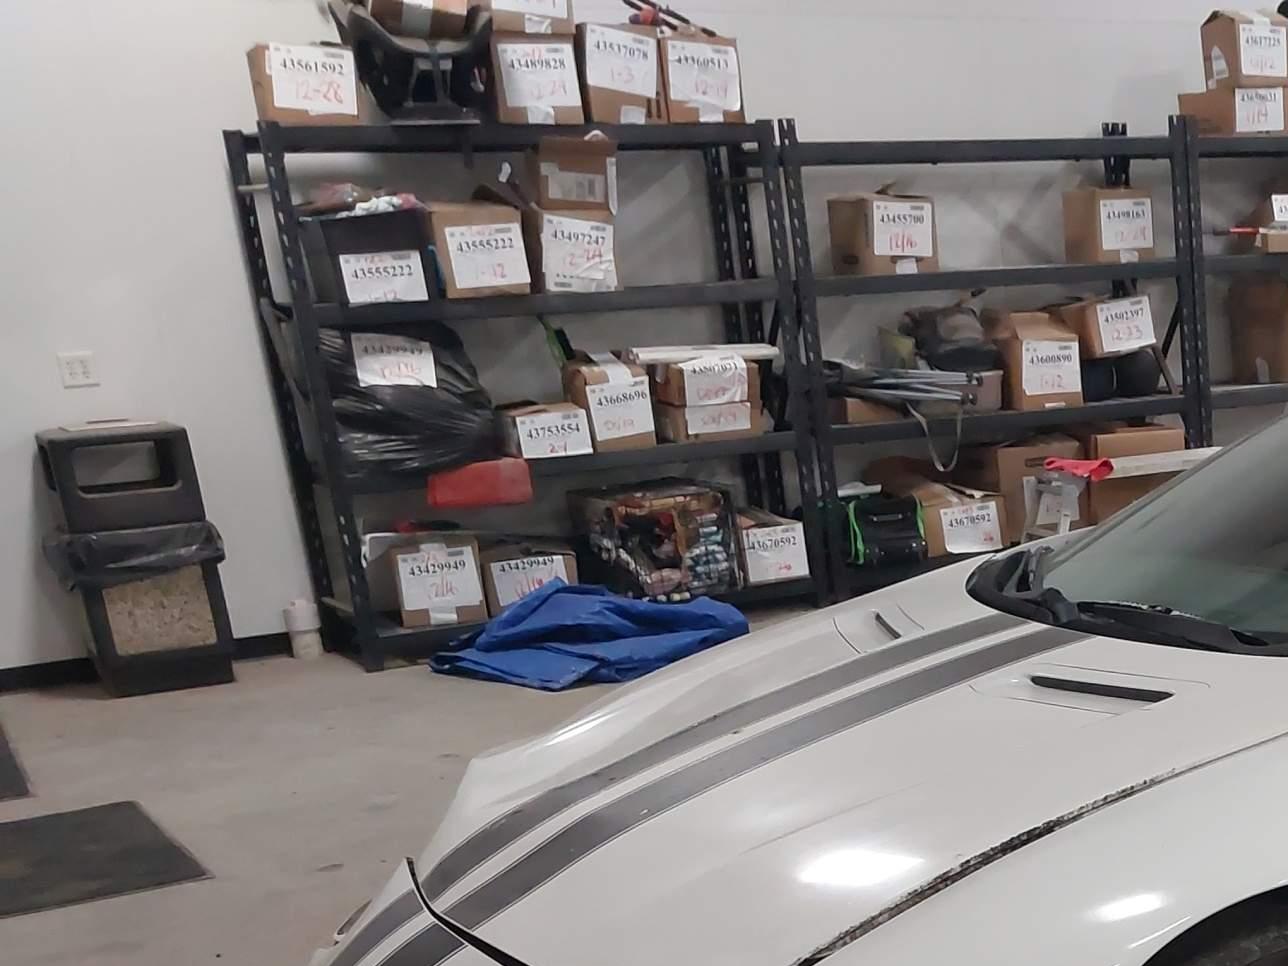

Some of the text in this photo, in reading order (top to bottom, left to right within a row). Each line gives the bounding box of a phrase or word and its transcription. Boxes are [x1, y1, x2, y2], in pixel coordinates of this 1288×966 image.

[593, 39, 649, 58] 43537078
[280, 58, 345, 76] 43561592
[509, 58, 567, 70] 43489828
[879, 213, 925, 225] 43455700
[457, 238, 515, 254] 43555222
[550, 228, 607, 247] 43497247
[351, 264, 413, 281] 43555222
[1028, 353, 1073, 366] 43600890
[596, 390, 648, 408] 43668696
[526, 422, 581, 441] 43753554
[948, 512, 992, 529] 43670592
[751, 535, 798, 553] 43670592
[408, 559, 467, 578] 43429949
[498, 557, 556, 574] 43429949
